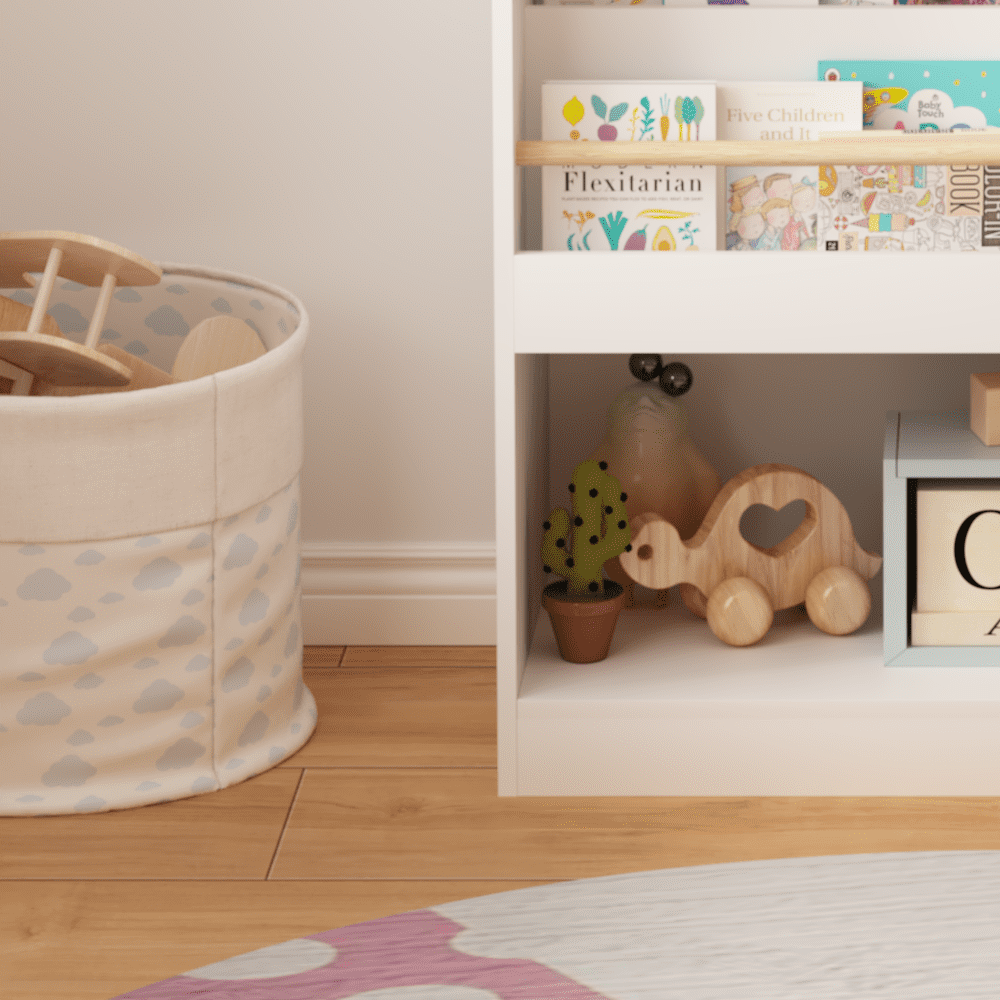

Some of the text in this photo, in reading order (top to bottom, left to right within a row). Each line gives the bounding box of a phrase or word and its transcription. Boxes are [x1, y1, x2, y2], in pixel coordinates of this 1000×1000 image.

[917, 99, 942, 111] Baby
[726, 107, 846, 123] Five Children
[917, 109, 945, 119] Touch
[759, 126, 812, 141] and It
[563, 170, 703, 193] Flexitarian
